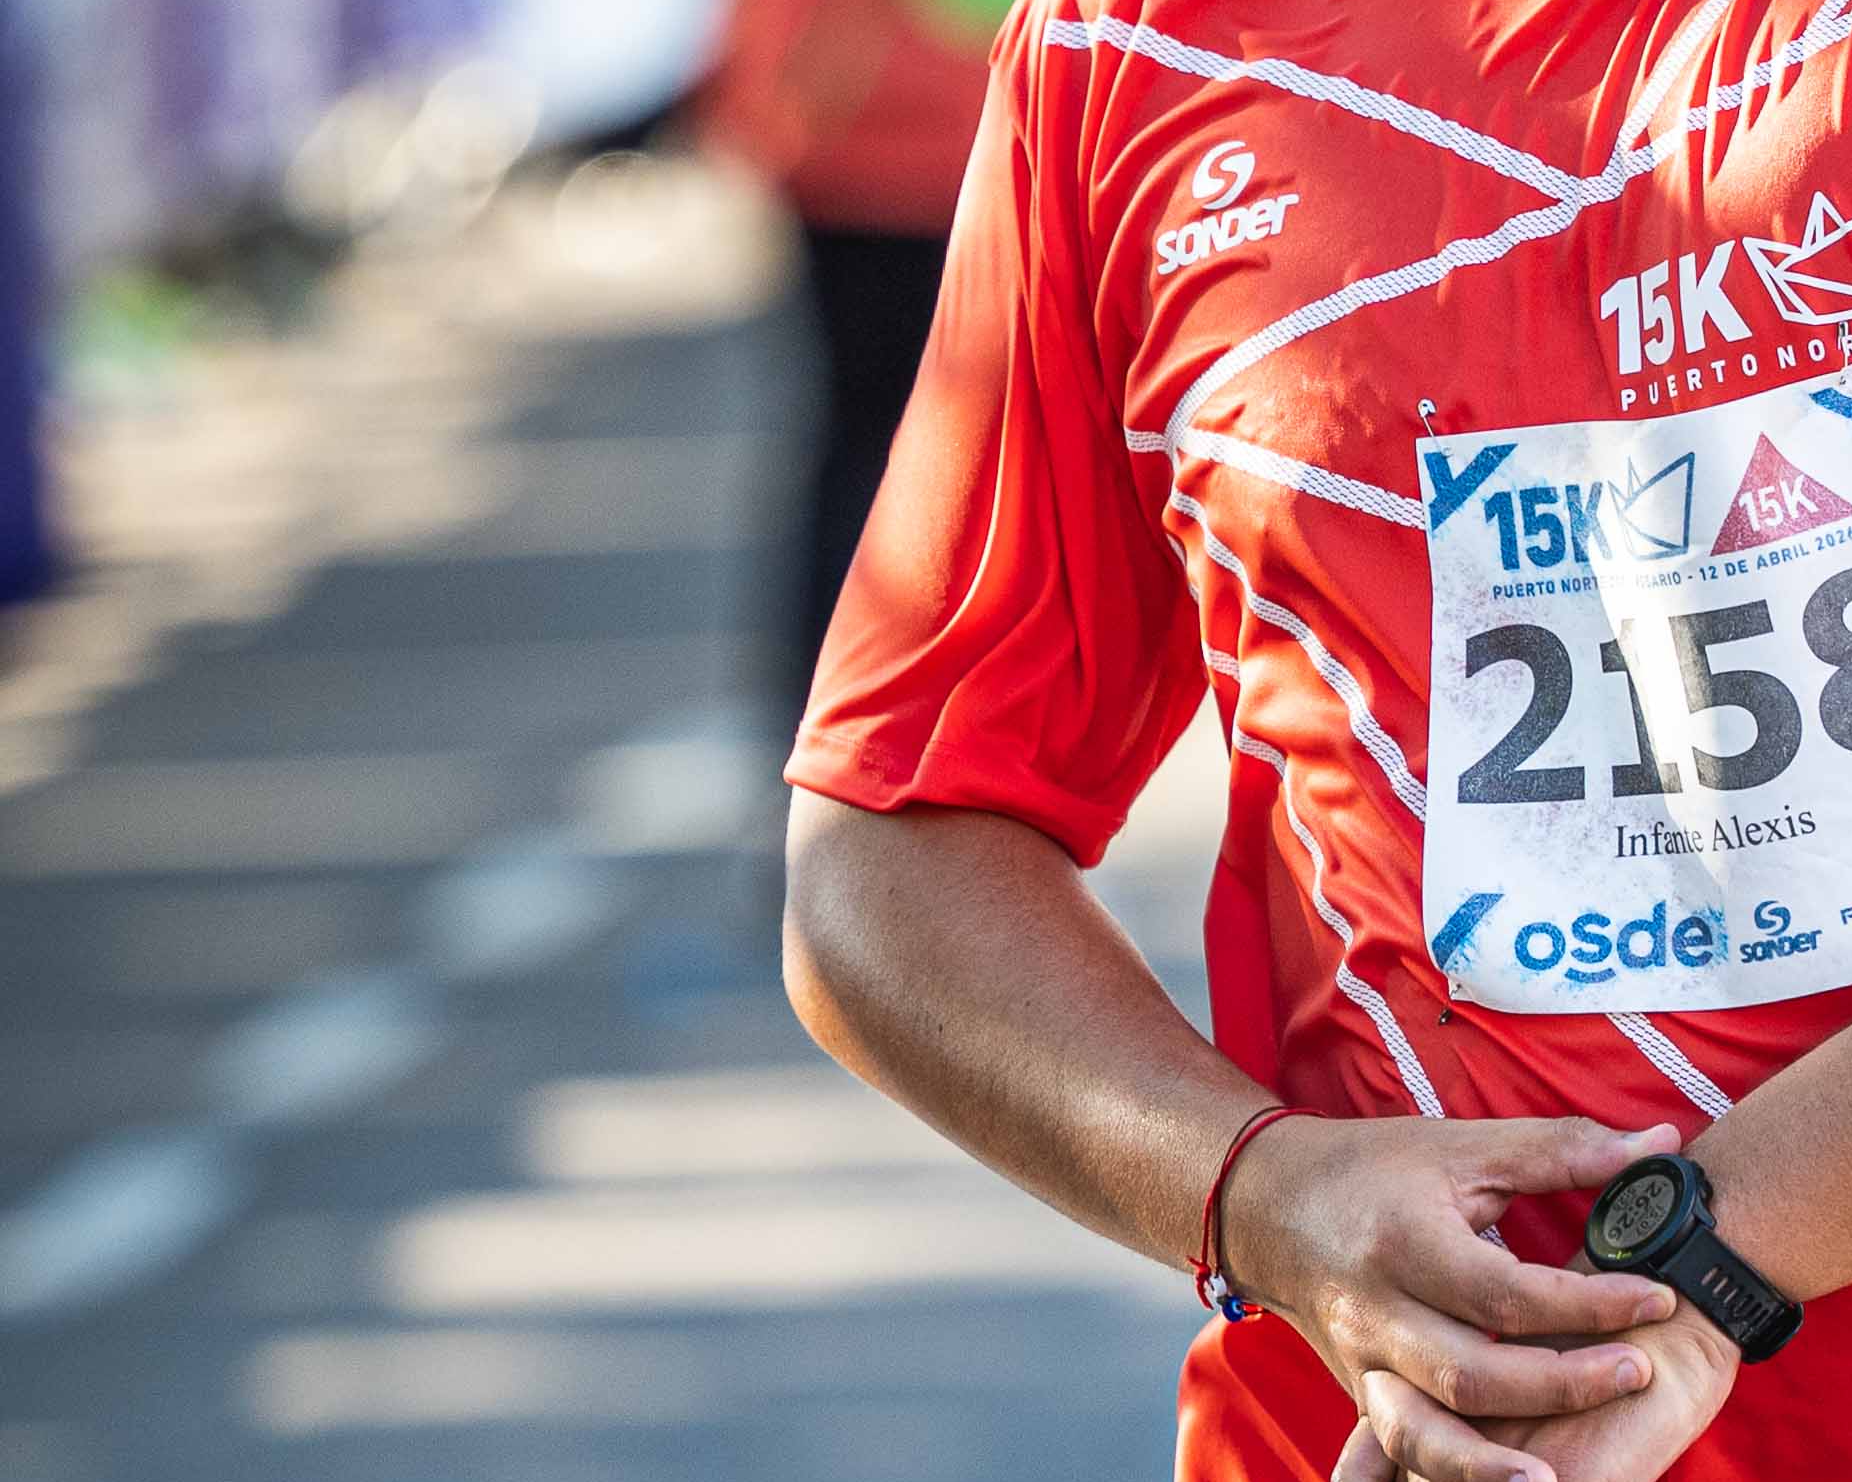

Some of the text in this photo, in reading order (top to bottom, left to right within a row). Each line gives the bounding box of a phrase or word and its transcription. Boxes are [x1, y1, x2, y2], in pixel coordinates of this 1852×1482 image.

[1600, 239, 1753, 375] 15K
[1620, 353, 1759, 412] PUERTO
[1484, 480, 1612, 572] 15K
[1738, 473, 1819, 534] 15K
[1492, 580, 1556, 601] PUERTO
[1699, 565, 1719, 582] 12
[1727, 559, 1749, 578] DE
[1757, 543, 1810, 571] ABRIL
[1614, 804, 1818, 859] Infante Alexis
[1513, 899, 1715, 974] osde
